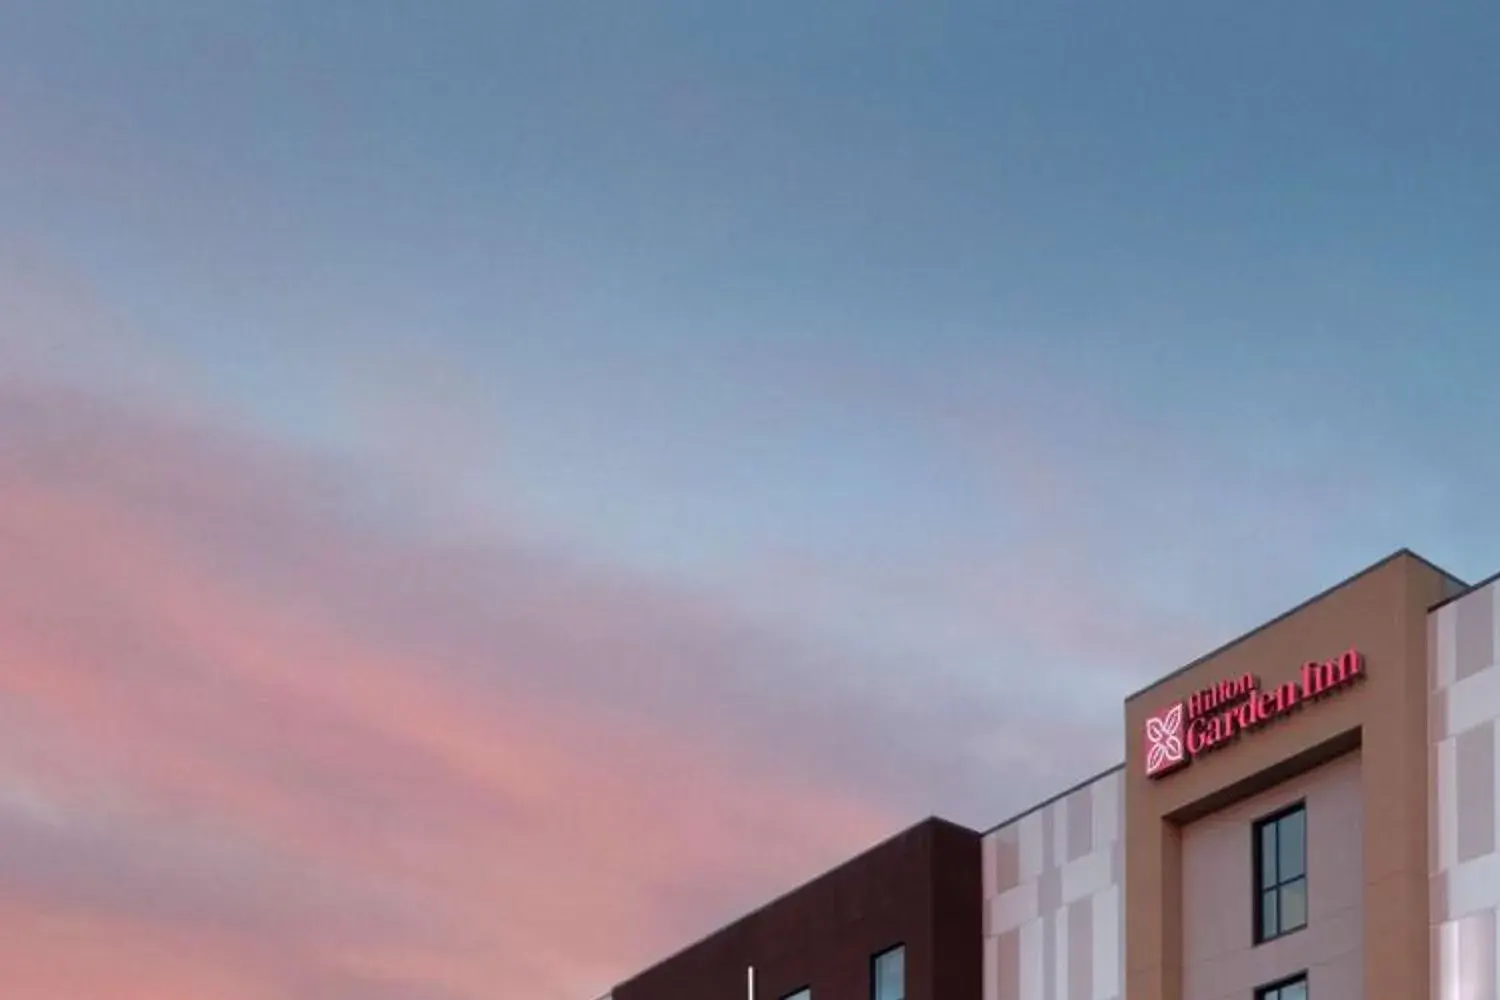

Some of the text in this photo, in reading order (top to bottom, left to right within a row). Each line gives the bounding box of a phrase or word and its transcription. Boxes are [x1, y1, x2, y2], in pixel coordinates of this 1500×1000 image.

[1187, 648, 1362, 755] Garden Inn
[1189, 672, 1254, 718] Hilton
